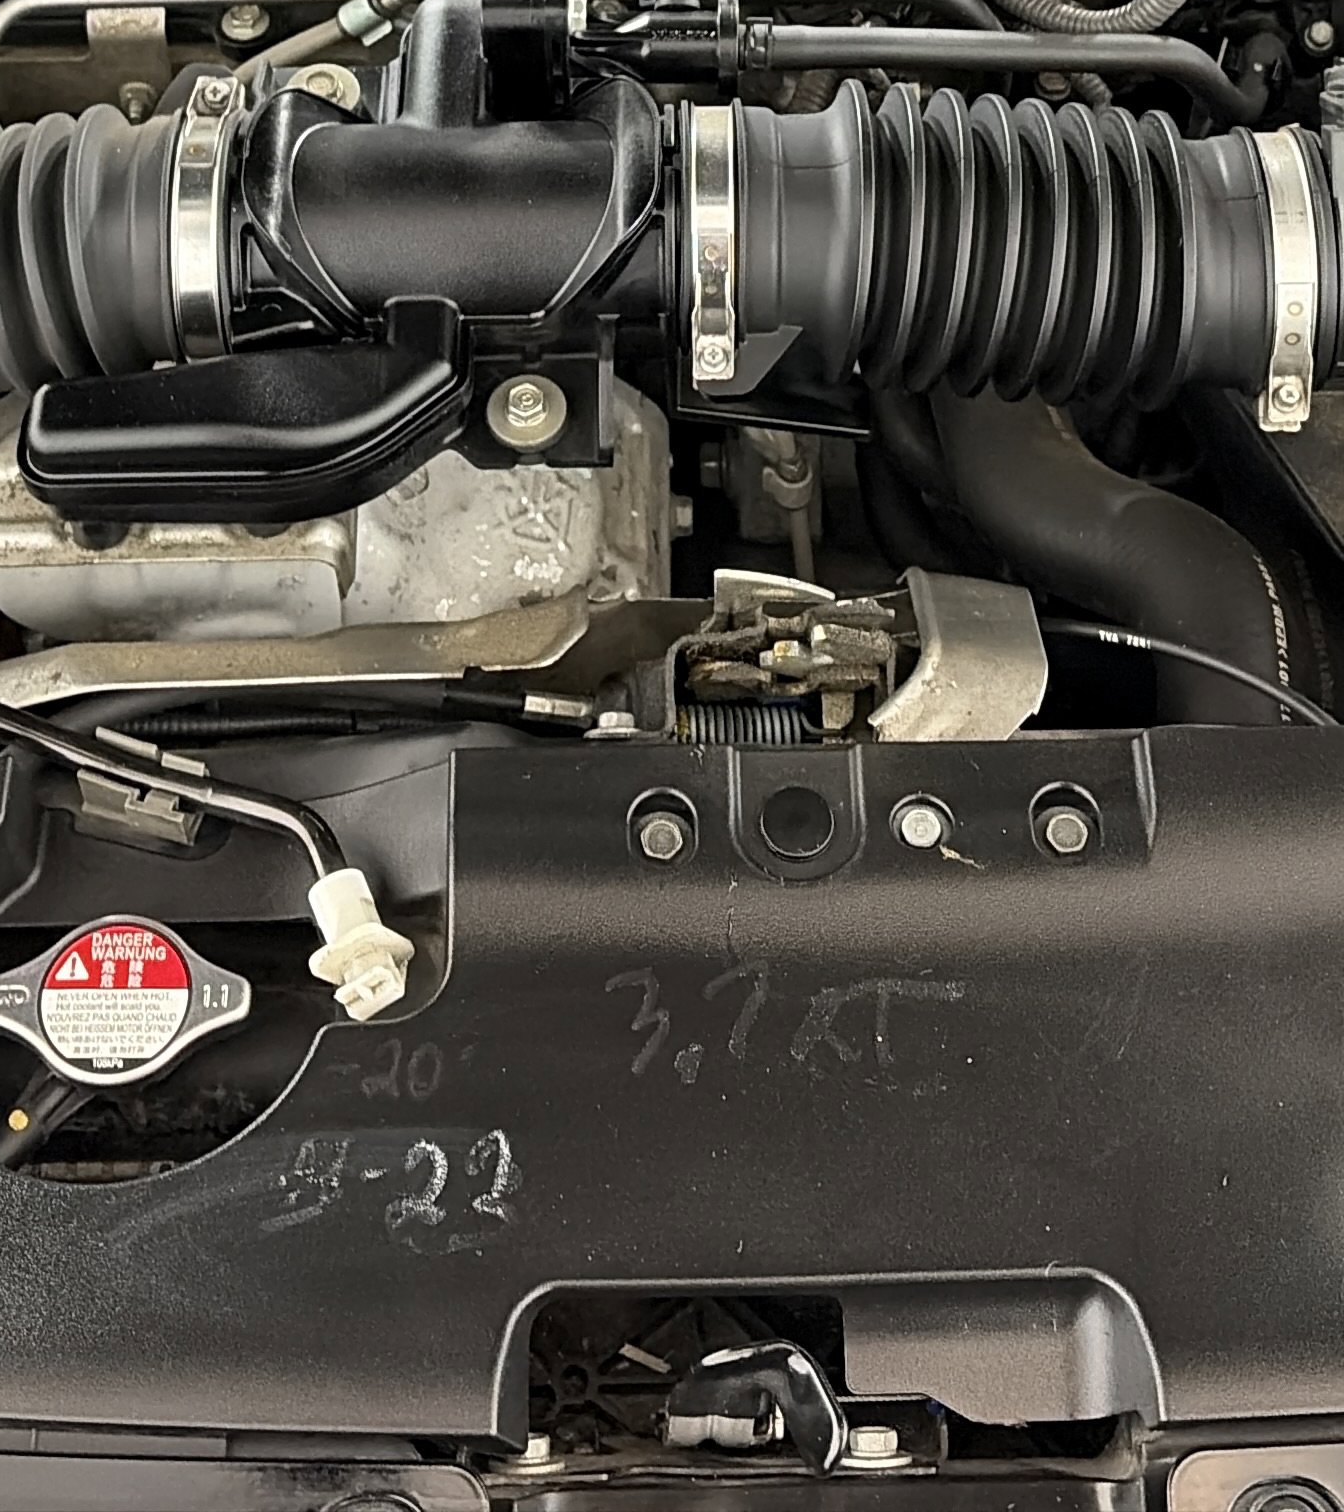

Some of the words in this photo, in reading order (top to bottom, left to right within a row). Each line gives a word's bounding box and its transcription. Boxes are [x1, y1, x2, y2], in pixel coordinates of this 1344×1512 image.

[92, 932, 154, 947] DANGER
[91, 946, 167, 961] WARNUNG
[202, 984, 230, 1008] 1.1
